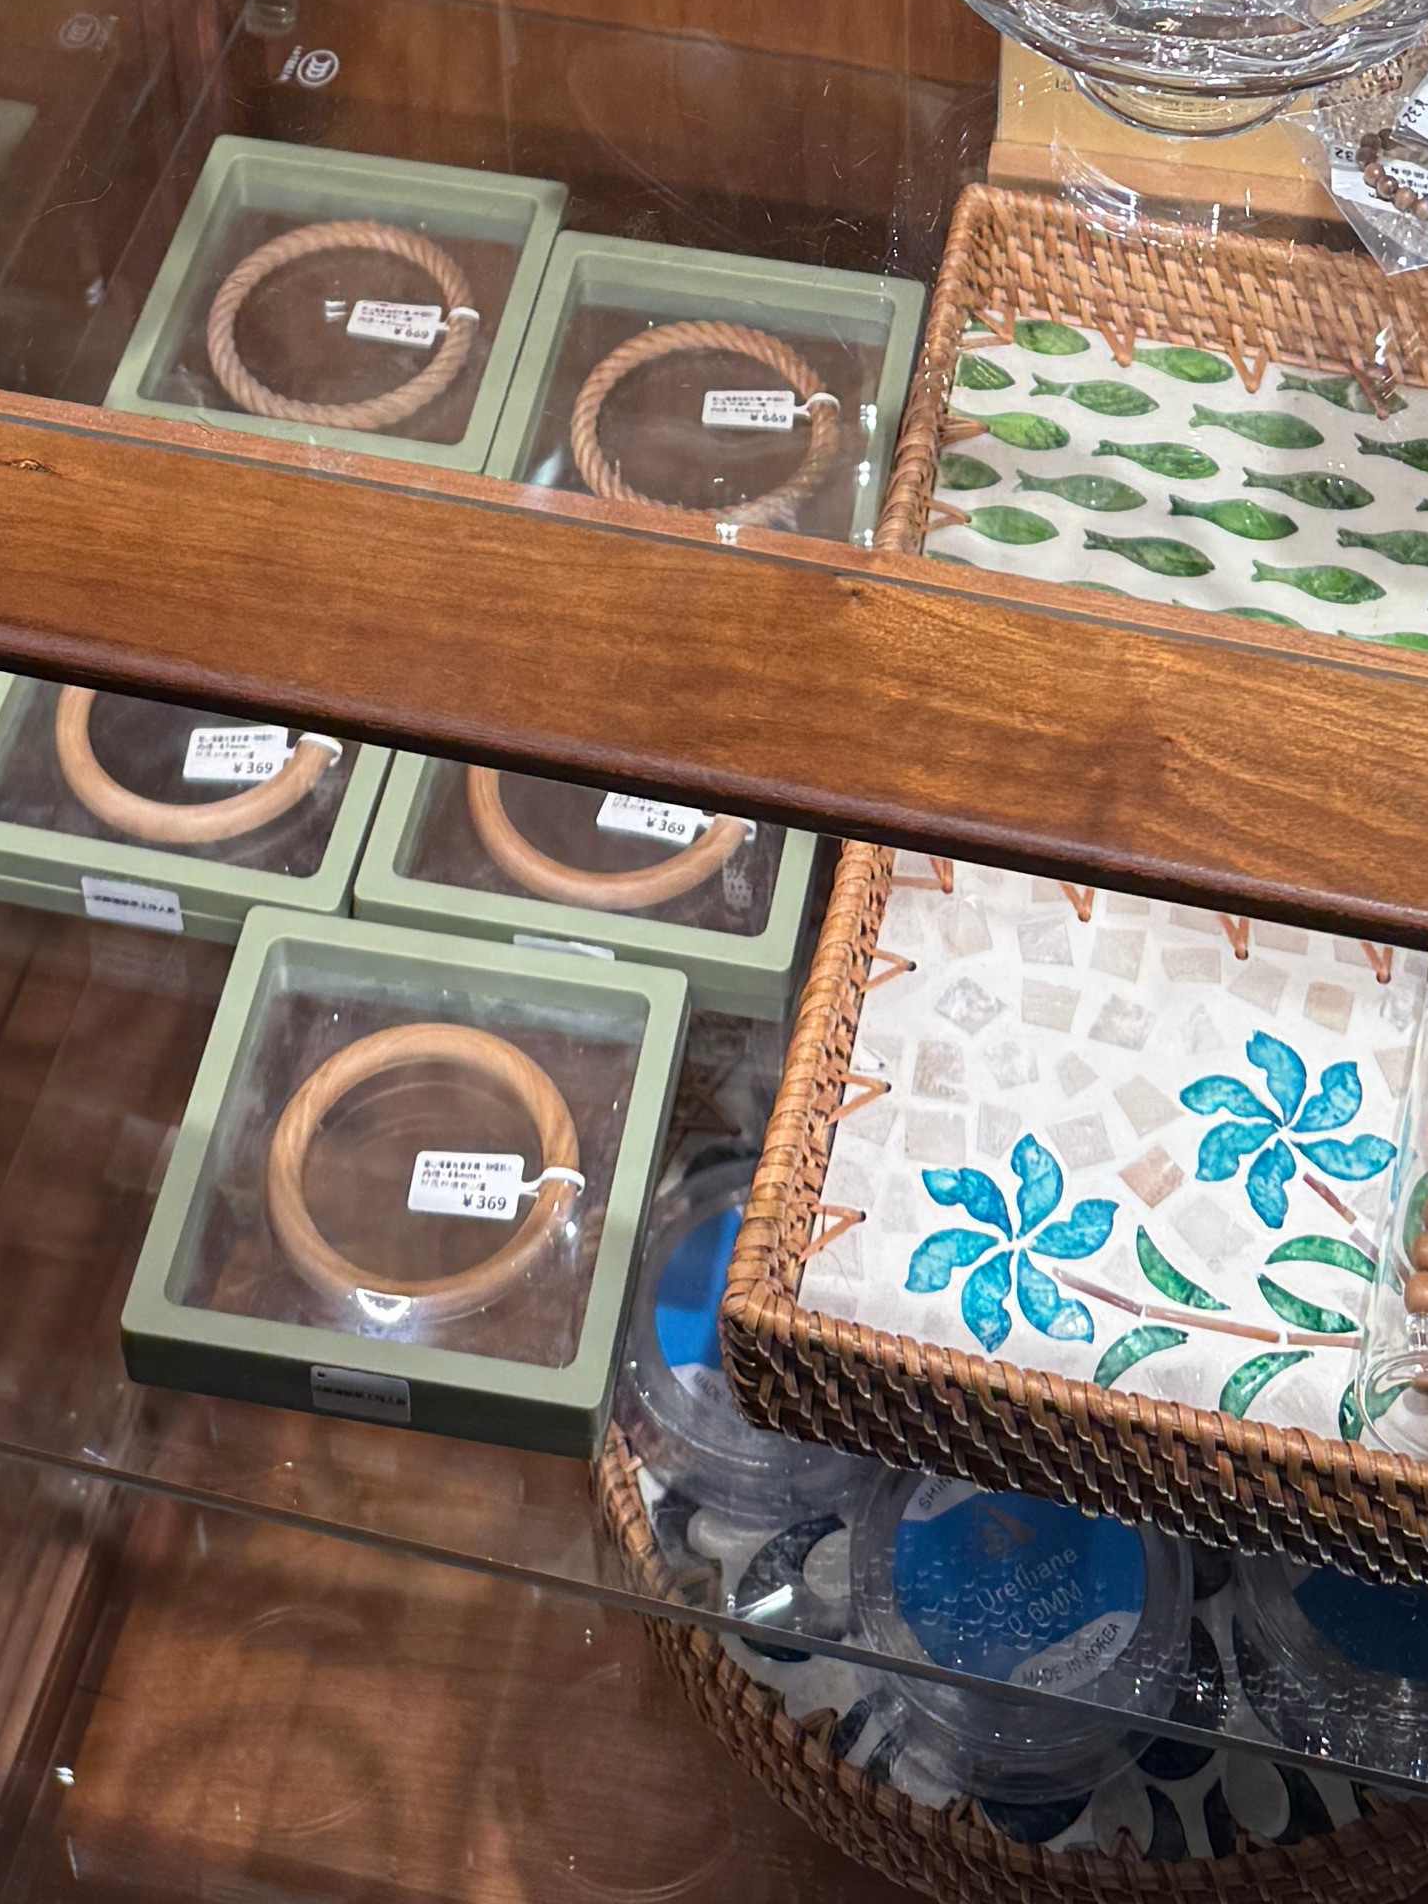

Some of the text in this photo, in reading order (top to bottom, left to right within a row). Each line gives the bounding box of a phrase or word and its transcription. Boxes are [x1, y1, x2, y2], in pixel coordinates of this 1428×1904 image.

[233, 762, 273, 774] ¥369
[646, 817, 685, 835] ¥369
[463, 1194, 507, 1210] ¥369
[976, 1548, 1079, 1616] Urethane
[1022, 1622, 1120, 1688] MADE IN KOREA
